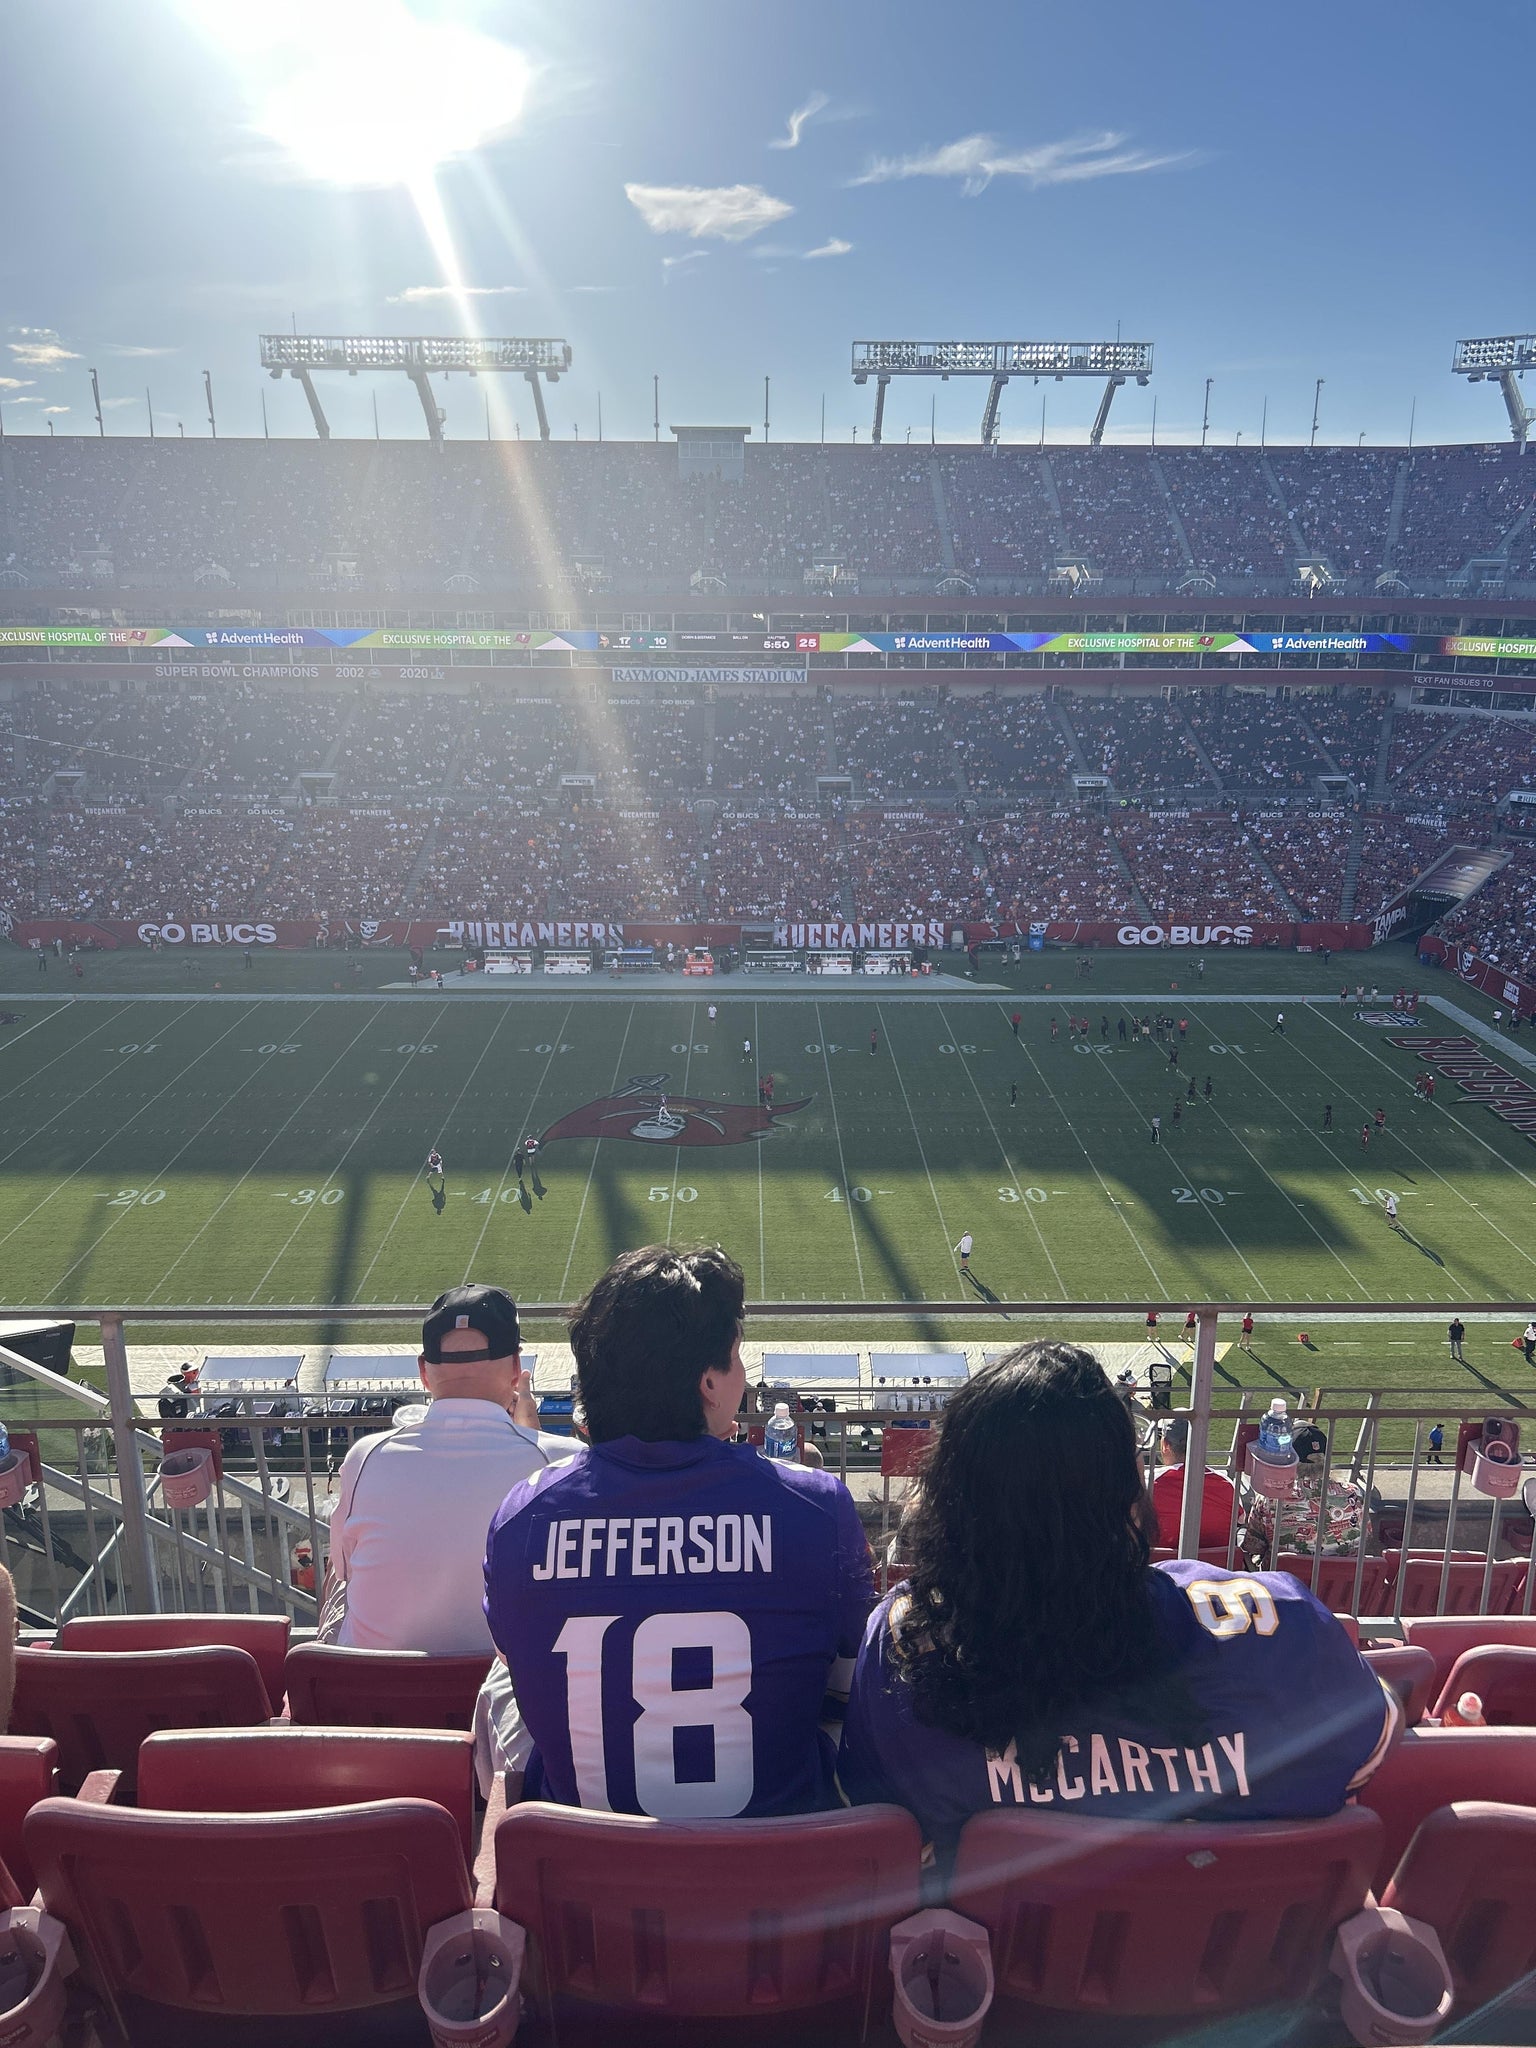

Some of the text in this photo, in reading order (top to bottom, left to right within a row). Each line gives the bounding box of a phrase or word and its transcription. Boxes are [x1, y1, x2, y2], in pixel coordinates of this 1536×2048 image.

[48, 632, 93, 642] HOSPITAL
[95, 633, 107, 642] OF
[108, 633, 127, 642] THE
[220, 632, 304, 644] AdventHealth
[383, 635, 511, 646] EXCLUSIVE HOSPITAL OF THE
[619, 636, 631, 645] 17
[654, 637, 667, 645] 10
[763, 640, 790, 649] 5:50
[798, 638, 817, 648] 25
[908, 637, 990, 648] AdventHealth
[1068, 638, 1194, 648] EXCLUSIVE HOSPITAL OF THE
[1285, 638, 1366, 649] AdventHealth
[1445, 641, 1496, 653] EXCLUSIVE
[155, 666, 198, 677] SUPER
[202, 666, 240, 677] BOWL
[243, 667, 319, 677] CHAMPIONS
[335, 667, 364, 677] 2002
[400, 668, 428, 679] 2020
[613, 670, 806, 683] RAYMOND JAMES STADIUM
[1413, 675, 1494, 687] TEXT FAN ISSUES TO
[1373, 906, 1407, 930] TAMPA
[137, 923, 277, 943] GO BUCS
[449, 921, 624, 948] BUCCANEERS
[774, 923, 944, 948] BUCCANEERS
[1117, 925, 1254, 945] GO BUCS
[1372, 927, 1391, 945] BAY
[107, 1189, 166, 1205] 20
[290, 1189, 345, 1205] 30
[471, 1187, 522, 1204] 40
[647, 1187, 698, 1203] 50
[824, 1187, 872, 1203] 40
[998, 1187, 1048, 1203] 30
[1171, 1187, 1225, 1204] 20
[1348, 1188, 1400, 1205] 10
[532, 1514, 773, 1581] JEFFERSON
[551, 1611, 755, 1818] 18
